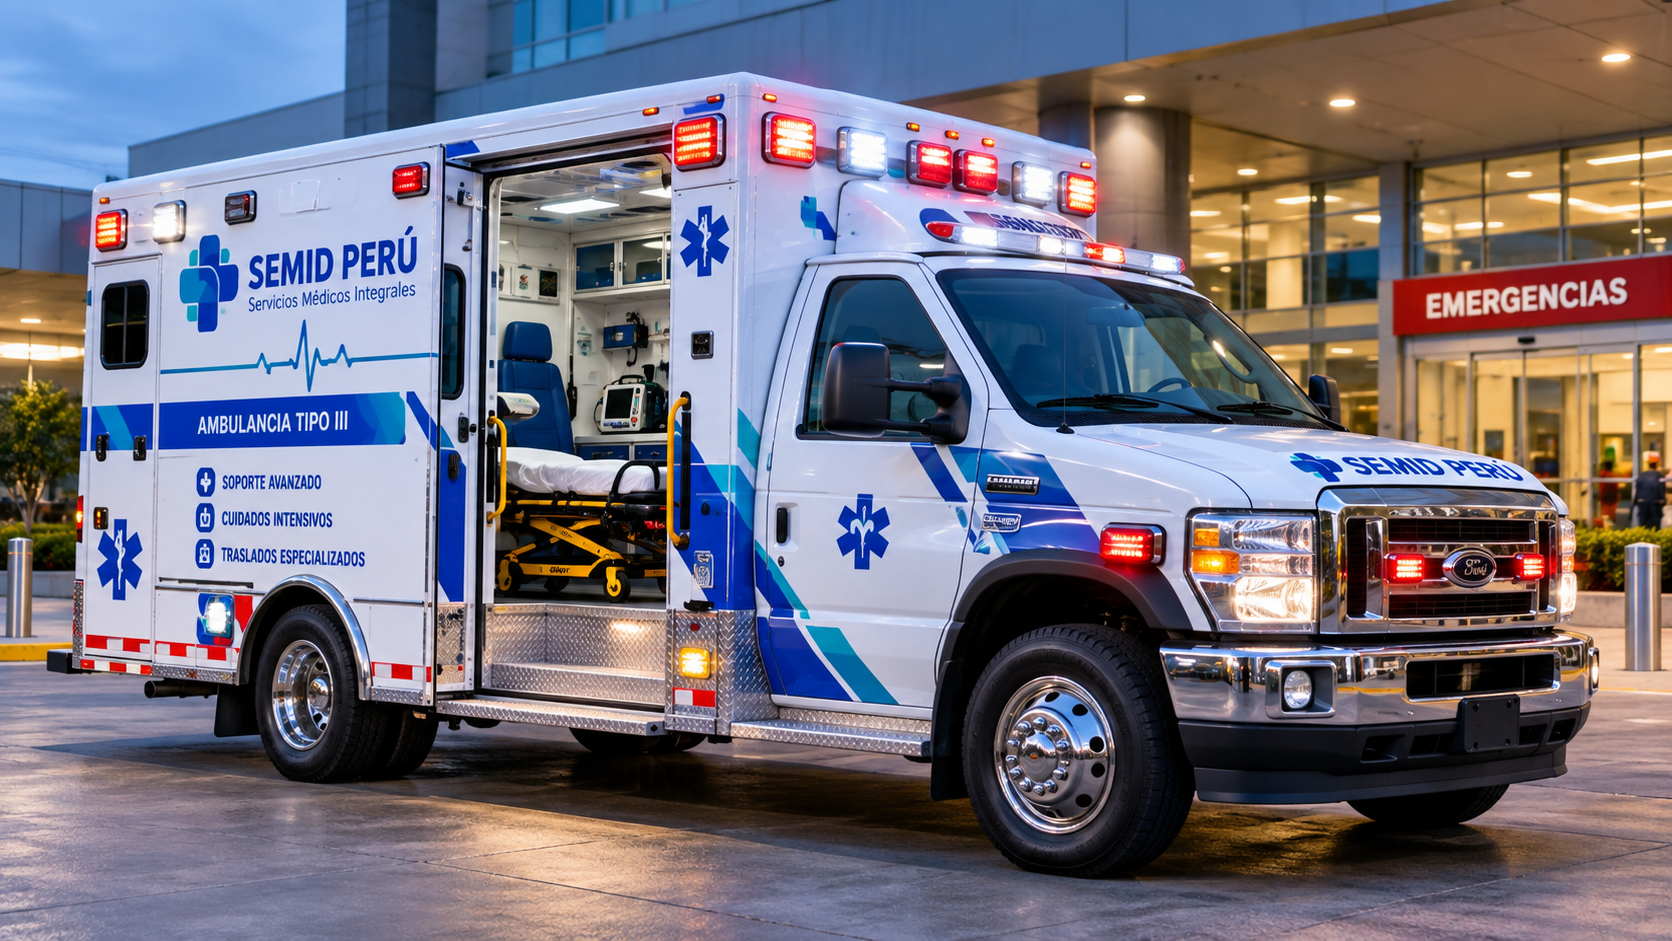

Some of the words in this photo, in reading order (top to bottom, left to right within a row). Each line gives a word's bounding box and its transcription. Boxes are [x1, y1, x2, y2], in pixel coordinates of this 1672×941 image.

[248, 247, 334, 290] SEMID
[342, 226, 418, 280] PERÚ
[248, 295, 298, 312] Servicios
[301, 289, 351, 307] Médicos
[354, 281, 416, 304] Integrales
[1426, 277, 1628, 319] EMERGENCIAS
[197, 413, 292, 435] AMBULANCIA
[295, 411, 330, 431] TIPO
[334, 410, 349, 430] III
[1342, 456, 1445, 476] SEMID
[1441, 458, 1524, 482] PERÚ
[222, 475, 266, 490] SOPORTE
[268, 474, 322, 490] AVANZADO
[221, 511, 271, 527] CUIDADOS
[273, 512, 333, 528] INTENSIVOS
[221, 547, 277, 565] TRASLADOS
[280, 549, 365, 567] ESPECIALIZADOS
